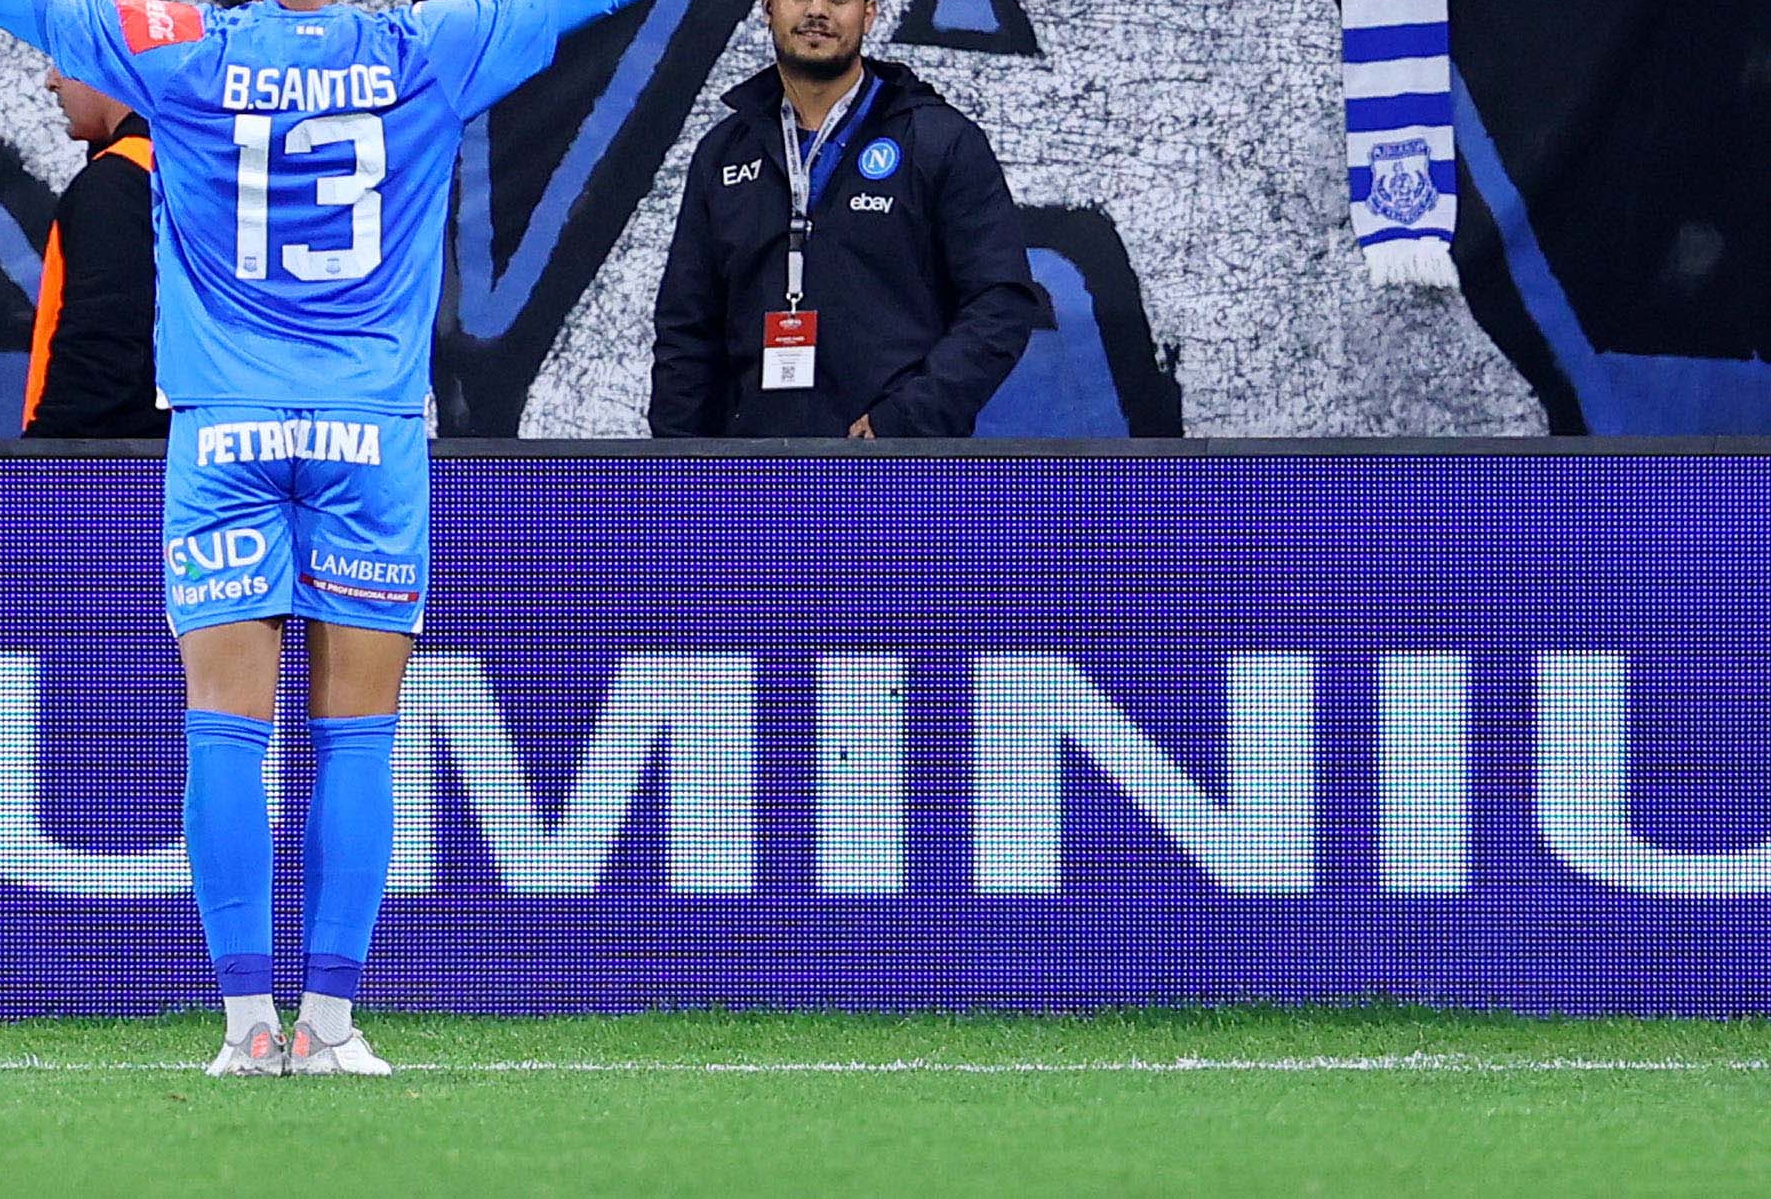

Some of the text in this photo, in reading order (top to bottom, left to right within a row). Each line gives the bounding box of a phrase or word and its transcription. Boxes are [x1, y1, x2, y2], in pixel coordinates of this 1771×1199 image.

[222, 64, 397, 111] B.SANTOS
[722, 159, 763, 187] EA7
[234, 112, 386, 282] 13
[850, 192, 894, 213] ebay
[196, 419, 381, 467] PETROLINA
[310, 549, 416, 585] LAMBERTS
[171, 574, 269, 607] Markets
